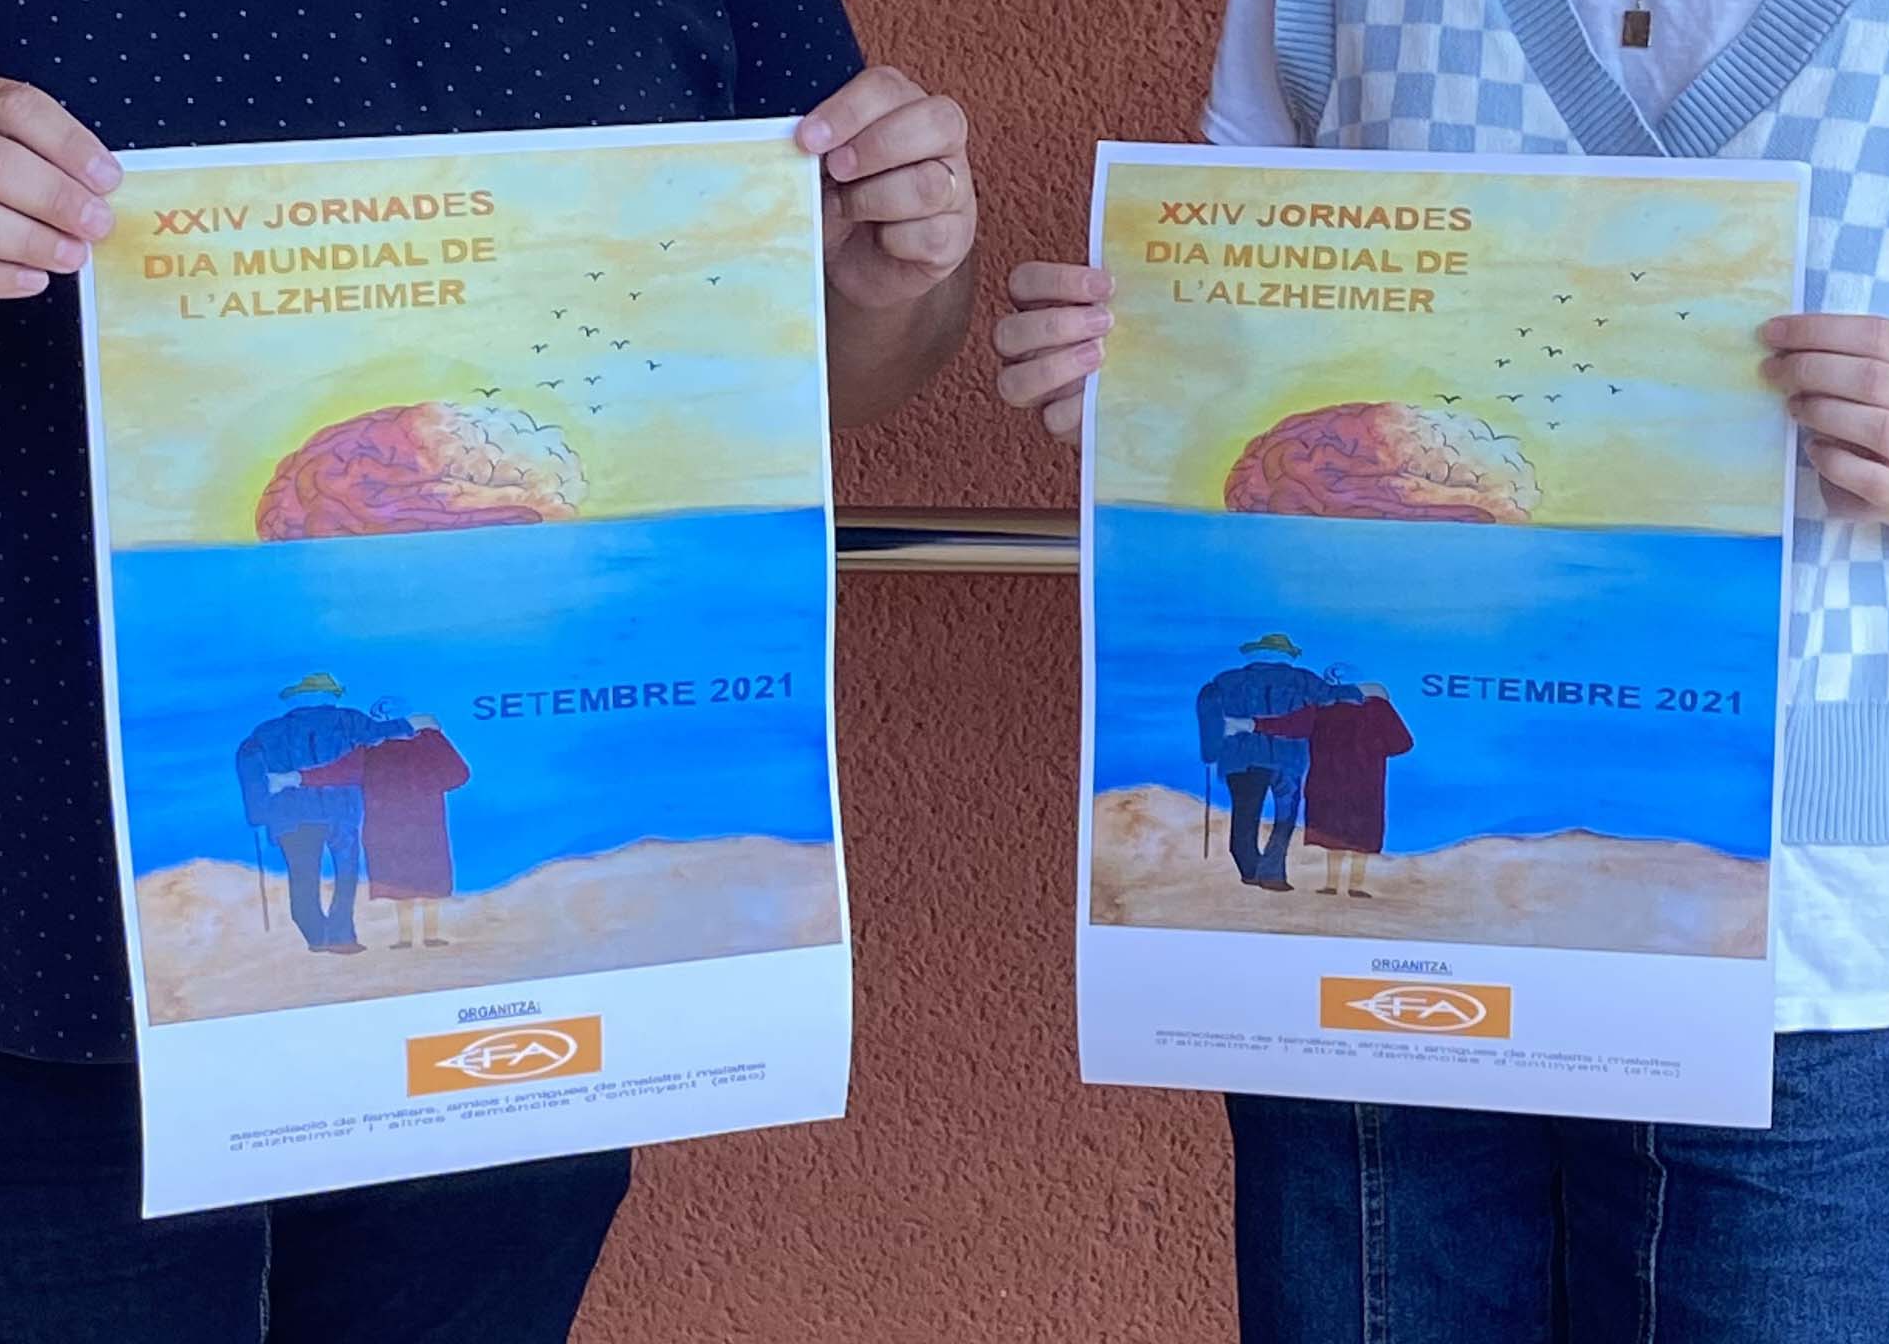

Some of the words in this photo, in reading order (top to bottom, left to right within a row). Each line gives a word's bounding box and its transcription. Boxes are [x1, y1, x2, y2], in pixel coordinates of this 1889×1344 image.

[153, 205, 249, 235] XXIV
[263, 190, 495, 230] JORNADES
[1158, 202, 1246, 225] XXIV
[1257, 203, 1472, 232] JORNADES
[144, 254, 219, 279] DIA
[233, 241, 429, 277] MUNDIAL
[442, 237, 498, 264] DE
[1145, 240, 1210, 265] DIA
[1224, 244, 1403, 273] MUNDIAL
[1417, 250, 1469, 275] DE
[180, 279, 467, 320] L'ALZHEIMER
[1173, 279, 1435, 313] L'ALZHEIMER
[472, 680, 697, 721] SETEMBRE
[710, 672, 793, 703] 2021
[1421, 674, 1641, 709] SETEMBRE
[1656, 687, 1741, 714] 2021
